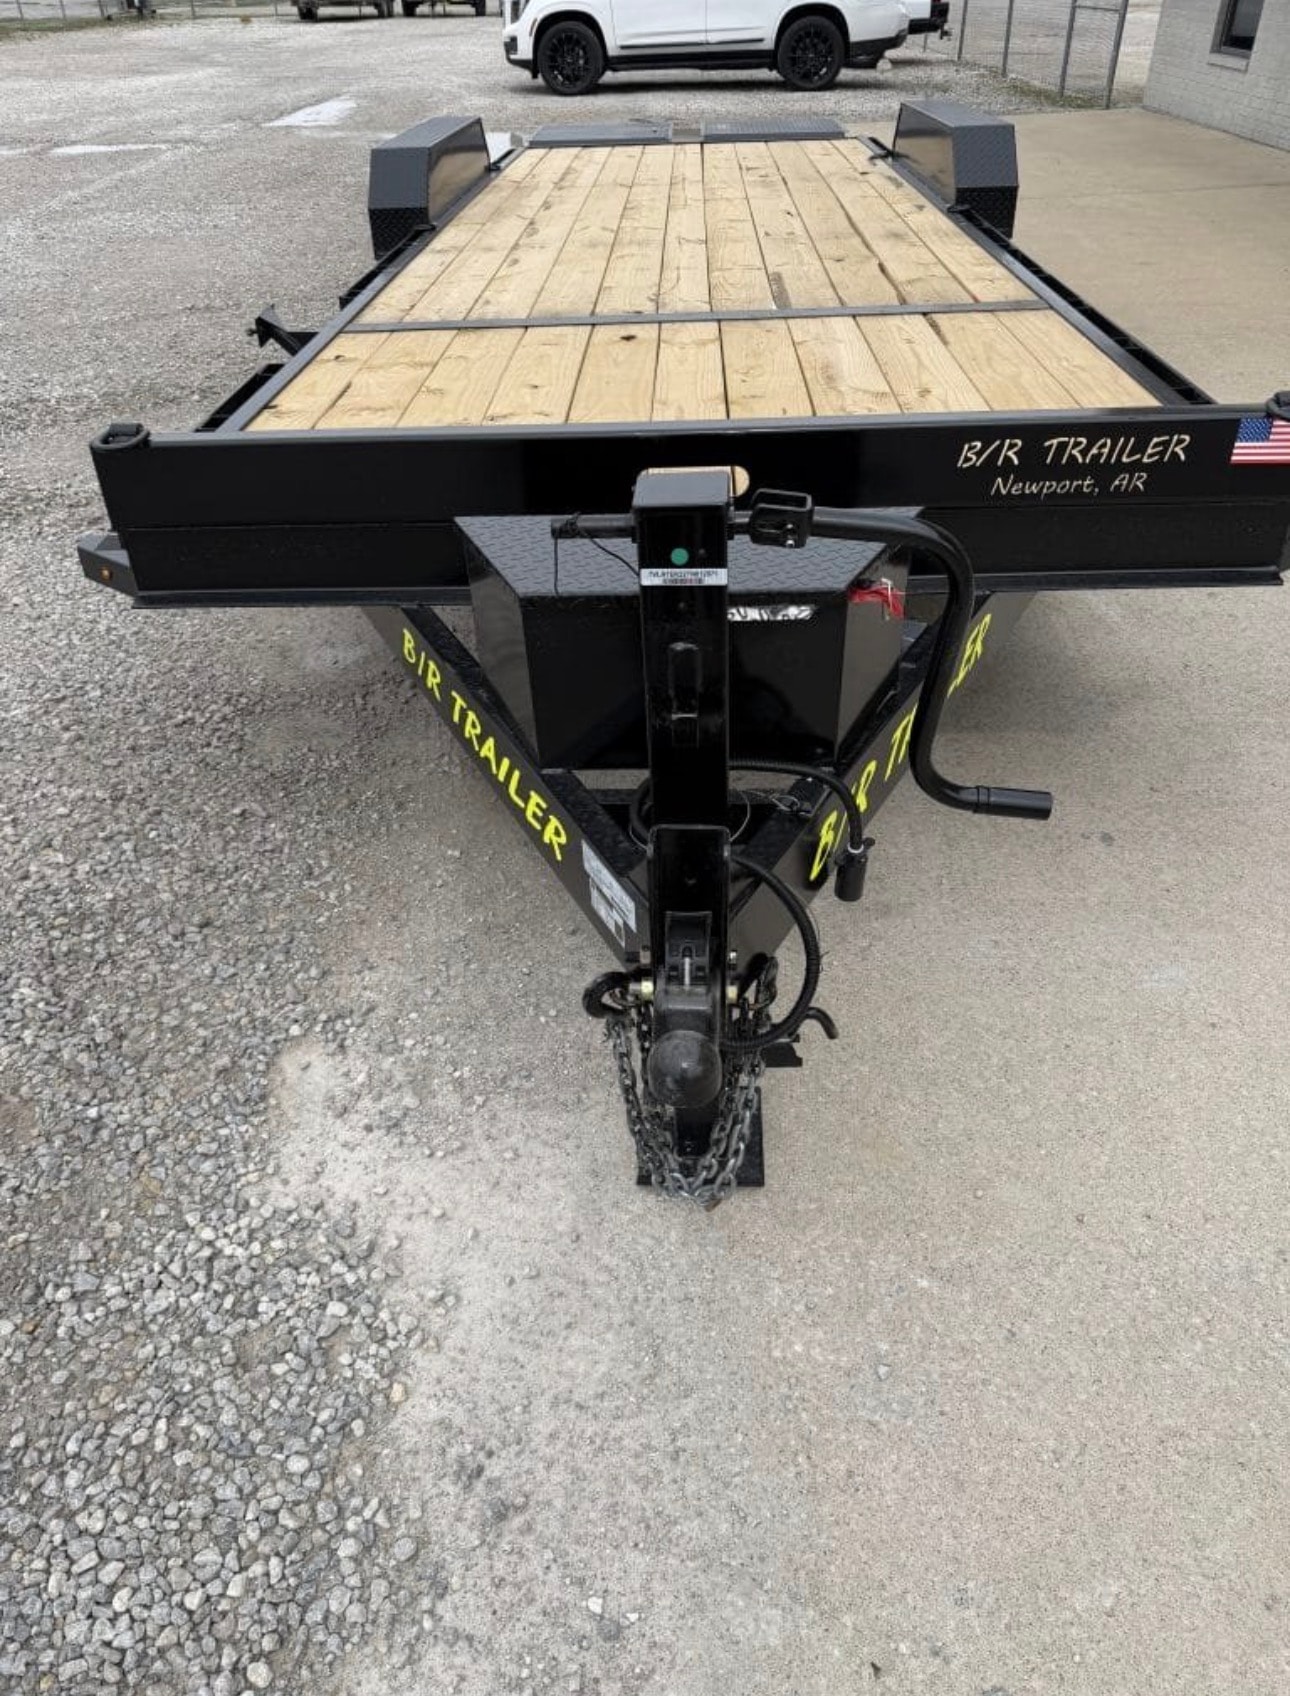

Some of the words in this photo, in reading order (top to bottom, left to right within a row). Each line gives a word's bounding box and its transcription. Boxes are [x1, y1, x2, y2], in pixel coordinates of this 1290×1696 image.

[957, 439, 1023, 468] B/R
[1043, 434, 1191, 464] TRAILER
[990, 474, 1099, 500] Newport,
[1109, 472, 1148, 493] AR
[402, 628, 441, 701] B/R
[451, 690, 567, 861] TRAILER
